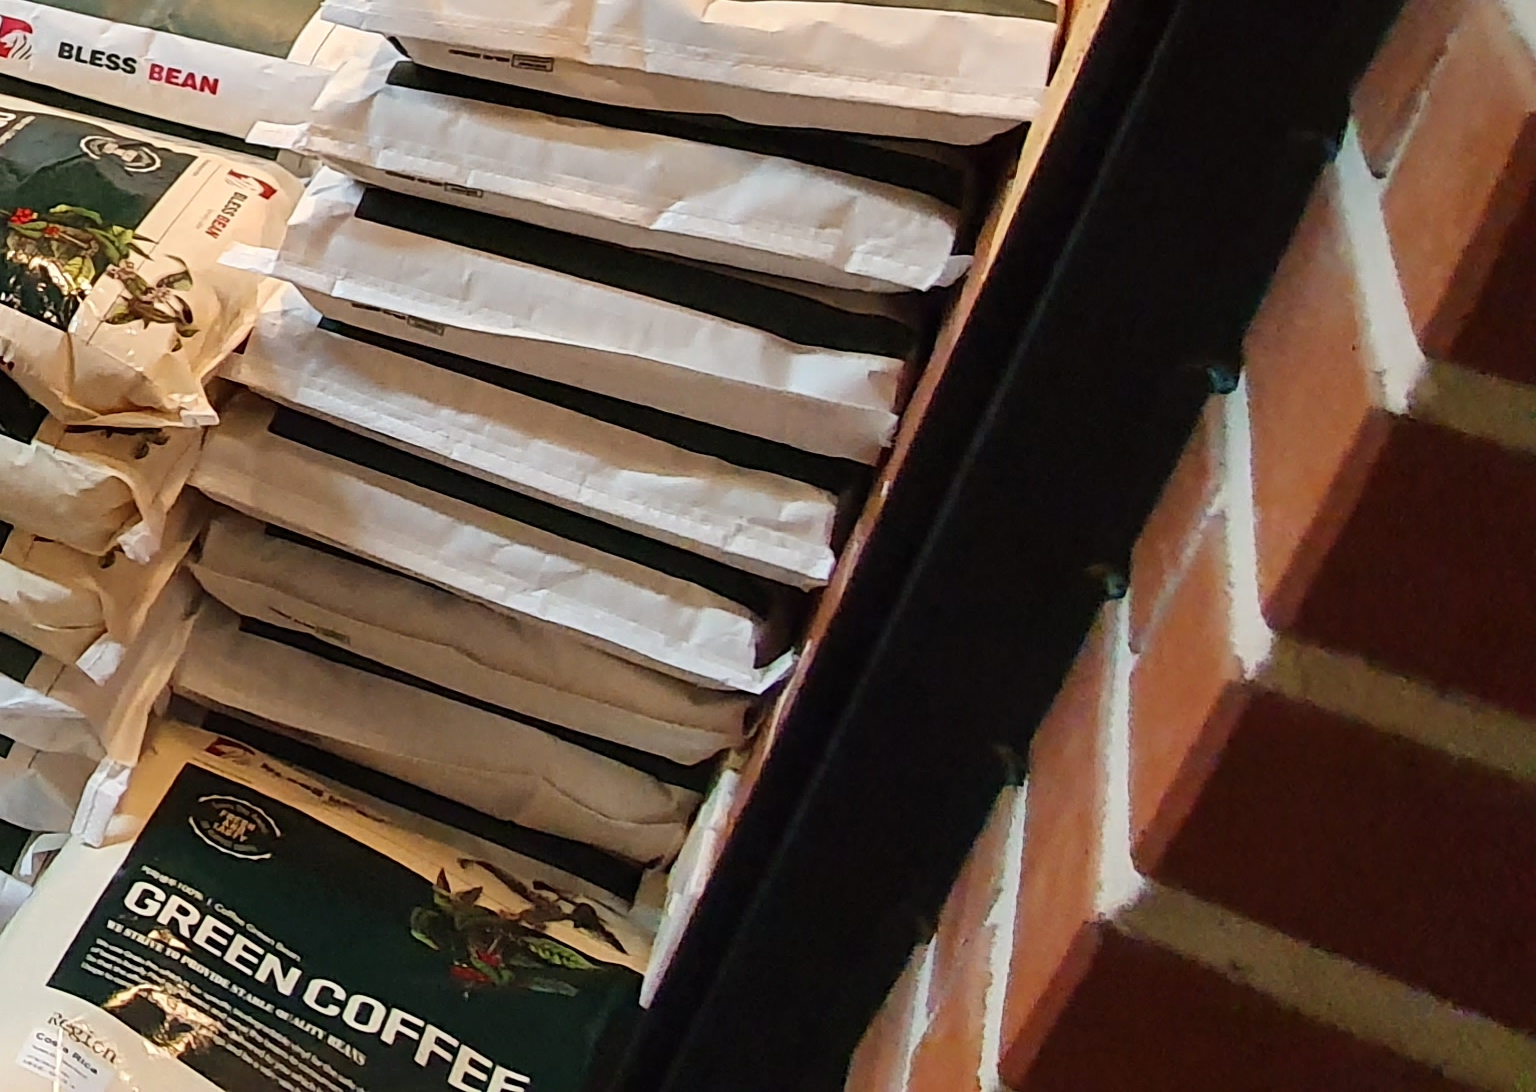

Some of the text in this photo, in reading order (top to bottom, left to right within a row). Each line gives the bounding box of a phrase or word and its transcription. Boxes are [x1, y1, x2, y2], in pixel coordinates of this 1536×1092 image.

[58, 42, 136, 75] BLESS
[148, 62, 219, 95] BEAN
[123, 880, 303, 997] GREEN
[302, 978, 531, 1092] COFFEE
[36, 1032, 70, 1055] Cosa
